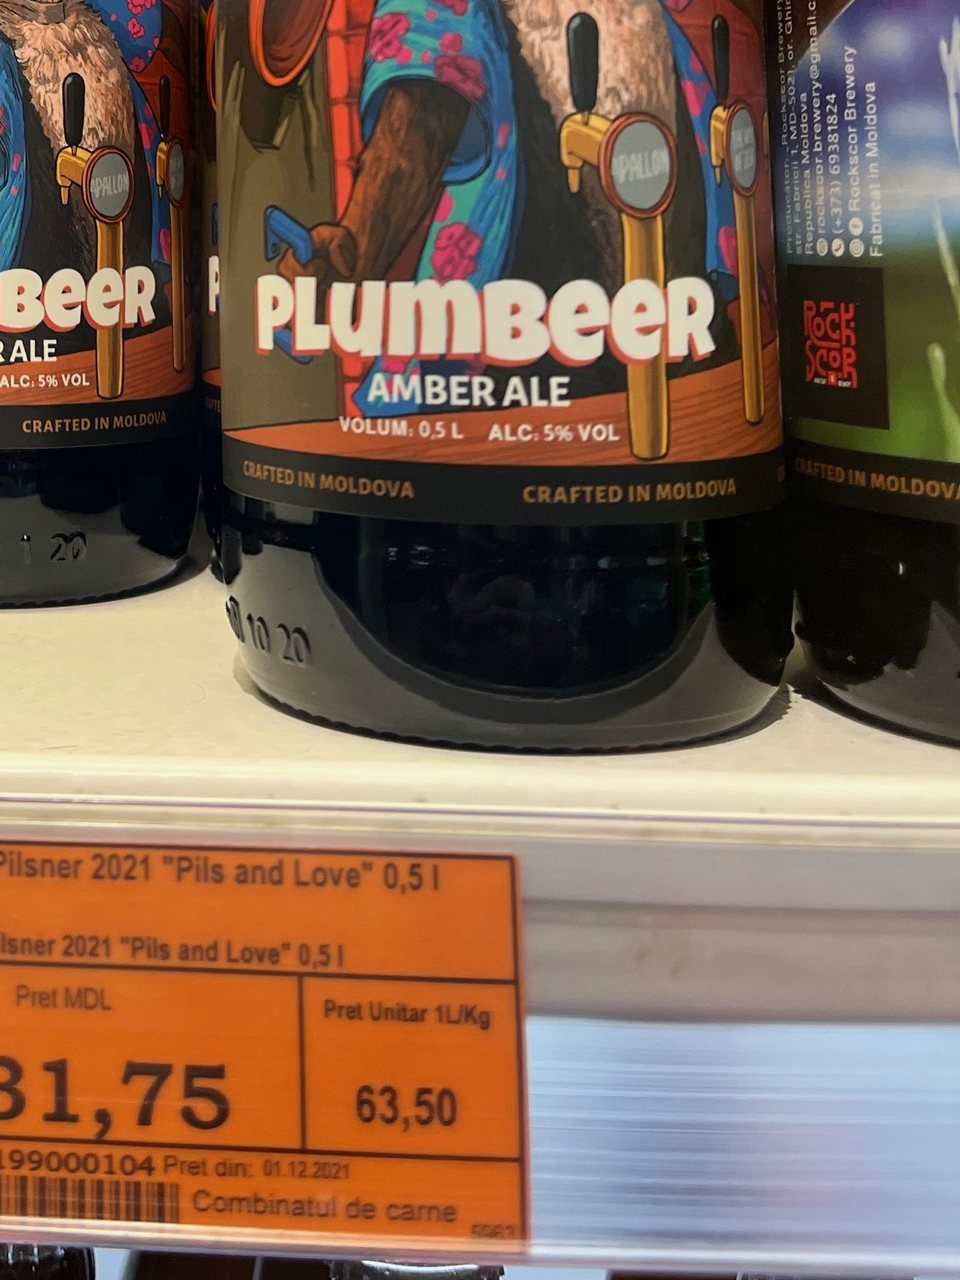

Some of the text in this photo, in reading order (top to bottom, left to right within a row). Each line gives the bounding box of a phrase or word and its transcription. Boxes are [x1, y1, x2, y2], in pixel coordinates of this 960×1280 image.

[844, 46, 861, 212] Rockscor Brewery
[864, 82, 878, 157] Moldova
[800, 92, 813, 255] Republica Moldova
[826, 93, 844, 234] (+373) 69381824
[868, 182, 883, 257] Fabricat
[9, 339, 57, 363] ALE
[38, 373, 59, 388] 5%
[61, 372, 90, 387] VOL
[367, 374, 571, 408] AMBER ALE
[21, 411, 167, 434] CRAFTED IN MOLDOVA
[451, 422, 464, 441] L
[543, 425, 574, 443] 5%
[578, 425, 620, 443] VOL
[243, 461, 415, 500] CRAFTED IN MOLDOVA
[522, 477, 737, 505] CRAFTED IN MOLDOVA
[847, 469, 867, 488] IN
[92, 853, 152, 881] 2021
[163, 854, 225, 884] "Pils
[235, 858, 284, 886] and
[294, 859, 373, 888] Love"
[383, 863, 424, 895] 0,5
[62, 935, 113, 958] 2021
[120, 936, 170, 961] "Pils
[178, 938, 218, 963] and
[227, 941, 291, 965] Love"
[299, 944, 331, 970] 0,5
[15, 985, 58, 1010] Pret
[63, 988, 112, 1012] MDL
[324, 999, 491, 1030] Pret Unitar 1L/Kg
[355, 1084, 458, 1132] 63,50
[164, 1155, 207, 1176] Pret
[215, 1157, 253, 1178] din:
[263, 1159, 350, 1180] 01.12.2021
[192, 1188, 457, 1223] Combinatul de carne
